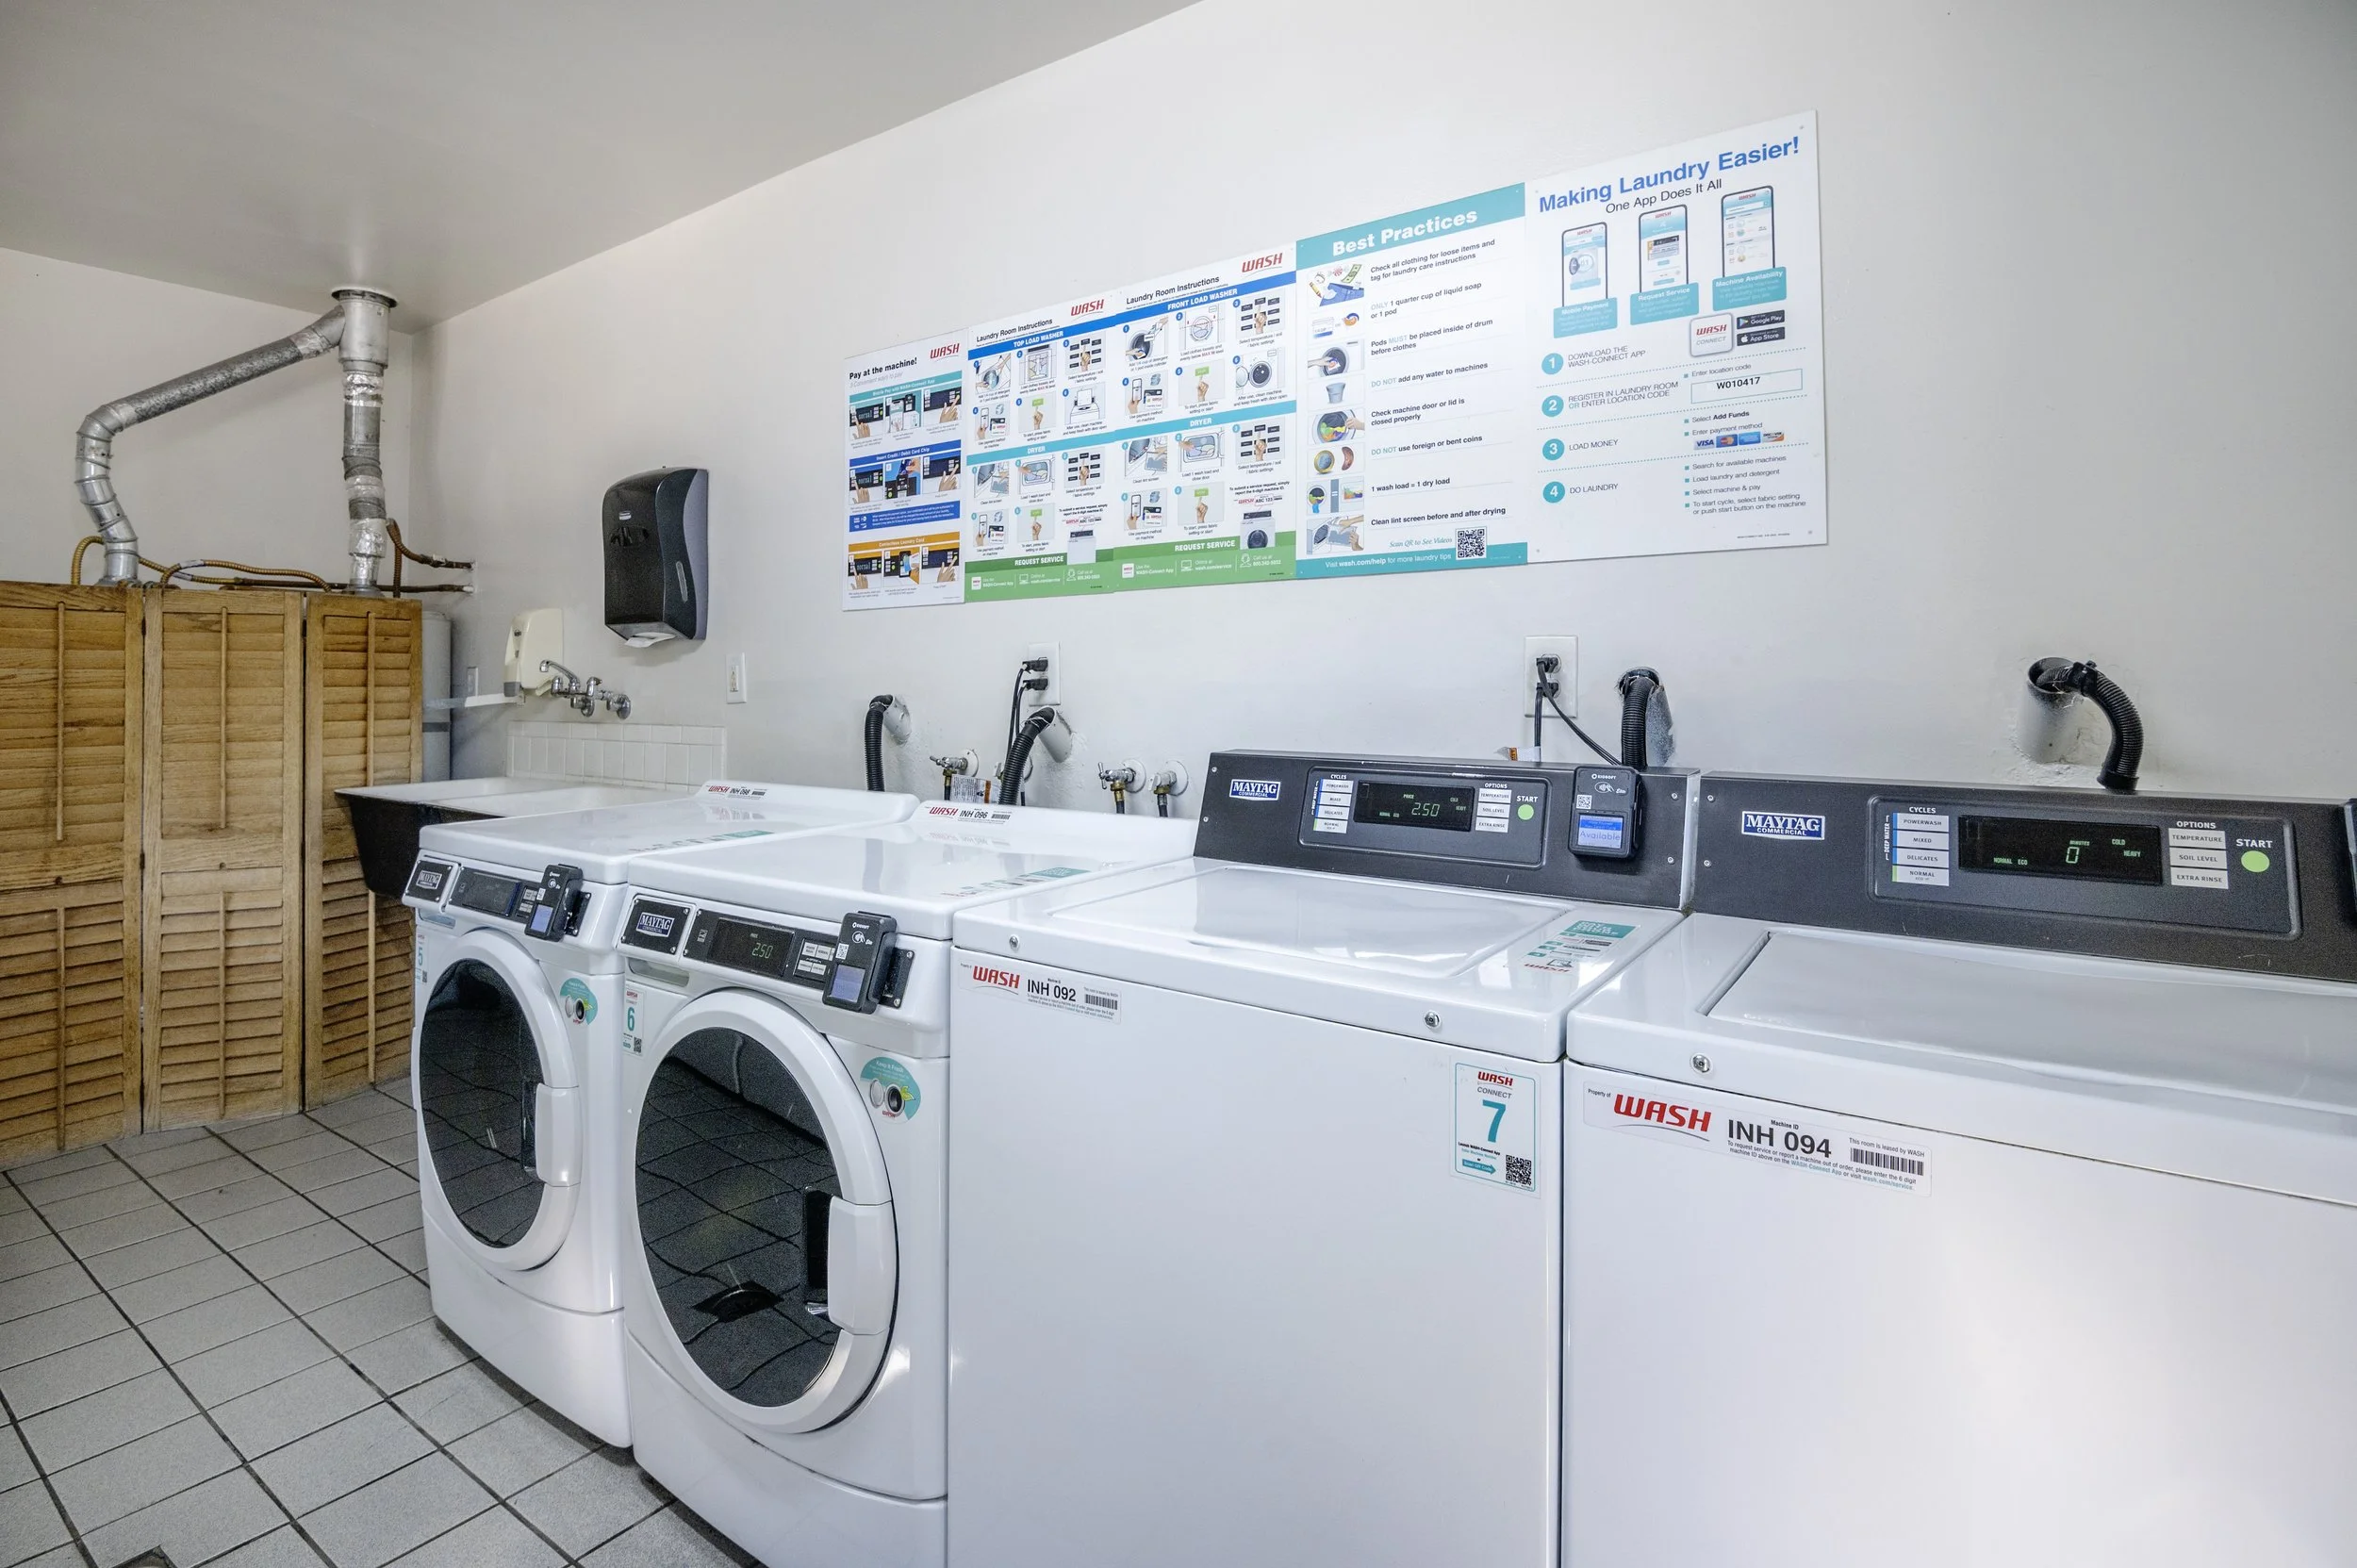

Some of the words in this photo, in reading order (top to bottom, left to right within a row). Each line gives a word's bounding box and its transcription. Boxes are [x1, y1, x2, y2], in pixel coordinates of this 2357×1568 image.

[1540, 185, 1611, 213] Making
[1620, 161, 1710, 194] Laundry
[1719, 136, 1799, 171] Easier!
[1606, 202, 1630, 214] One
[1634, 196, 1657, 207] App
[1661, 188, 1692, 202] Does
[1696, 184, 1703, 193] It
[1706, 178, 1722, 191] All
[1333, 234, 1376, 256] Best
[1381, 211, 1477, 244] Practices
[1242, 253, 1283, 273] WASH
[1370, 264, 1391, 273] Check
[1401, 256, 1428, 266] clothing
[1441, 249, 1459, 257] loose
[1461, 243, 1480, 253] items
[1481, 239, 1495, 248] and
[1393, 267, 1418, 276] laundry
[1435, 254, 1476, 267] instructions
[1127, 293, 1154, 305] Laundry
[1155, 288, 1176, 297] Room
[1178, 276, 1220, 292] Instructions
[1167, 300, 1189, 310] FRONT
[1191, 296, 1209, 305] LOAD
[1210, 289, 1238, 300] WASHER
[1071, 299, 1105, 317] WASH
[977, 333, 999, 342] Laundry
[1000, 328, 1017, 337] Room
[1018, 319, 1053, 332] Instructions
[1696, 324, 1727, 336] WASH
[1026, 337, 1040, 345] LOAD
[1041, 331, 1063, 341] WASHER
[1696, 337, 1726, 346] CONNECT
[931, 343, 960, 359] WASH
[1568, 348, 1612, 361] DOWNLOAD
[1613, 345, 1628, 354] THE
[1548, 357, 1556, 369] 1
[1568, 353, 1629, 368] WASH-CONNECT
[1630, 350, 1646, 358] APP
[849, 371, 862, 380] Pay
[864, 369, 870, 377] at
[872, 367, 883, 375] the
[885, 357, 917, 371] machine!
[1717, 377, 1761, 389] W010417
[1569, 391, 1605, 403] REGISTER
[1615, 385, 1652, 396] LAUNDRY
[1654, 381, 1679, 390] ROOM
[1581, 399, 1606, 408] ENTER
[1607, 393, 1646, 404] LOCATION
[1647, 389, 1670, 399] CODE
[1549, 400, 1558, 412] 2
[1190, 418, 1212, 427] DRYER
[1446, 437, 1462, 446] bent
[1549, 442, 1558, 455] 3
[1569, 442, 1590, 451] LOAD
[1591, 439, 1619, 448] MONEY
[1550, 486, 1558, 498] 4
[1583, 484, 1619, 493] LAUNDRY
[1175, 543, 1206, 552] REQUEST
[1207, 540, 1235, 549] SERVICE
[1339, 558, 1387, 567] wash.com/help
[1233, 782, 1277, 794] MAYTAG
[930, 807, 959, 816] WASH
[960, 810, 974, 818] INH
[1411, 802, 1441, 817] 2.50
[1746, 815, 1820, 832] MAYTAG
[2177, 820, 2217, 830] OPTIONS
[1580, 831, 1620, 842] Available
[1757, 828, 1806, 836] COMMERCIAL
[2172, 834, 2222, 843] TEMPERATURE
[2235, 838, 2273, 849] START
[2066, 847, 2080, 864] 0
[639, 915, 671, 930] MAYTAG
[419, 947, 423, 966] 5
[972, 966, 1020, 989] WASH
[1028, 980, 1049, 997] INH
[1054, 985, 1076, 1002] 092
[627, 1007, 635, 1032] 6
[1477, 1071, 1513, 1086] WASH
[1477, 1086, 1512, 1099] CONNECT
[1613, 1094, 1712, 1132] WASH
[1482, 1099, 1507, 1143] 7
[1771, 1119, 1792, 1129] Machine
[1728, 1119, 1774, 1147] INH
[1784, 1131, 1831, 1158] 094
[1849, 1137, 1860, 1146] This
[1882, 1145, 1899, 1153] leased
[1907, 1149, 1925, 1158] WASH
